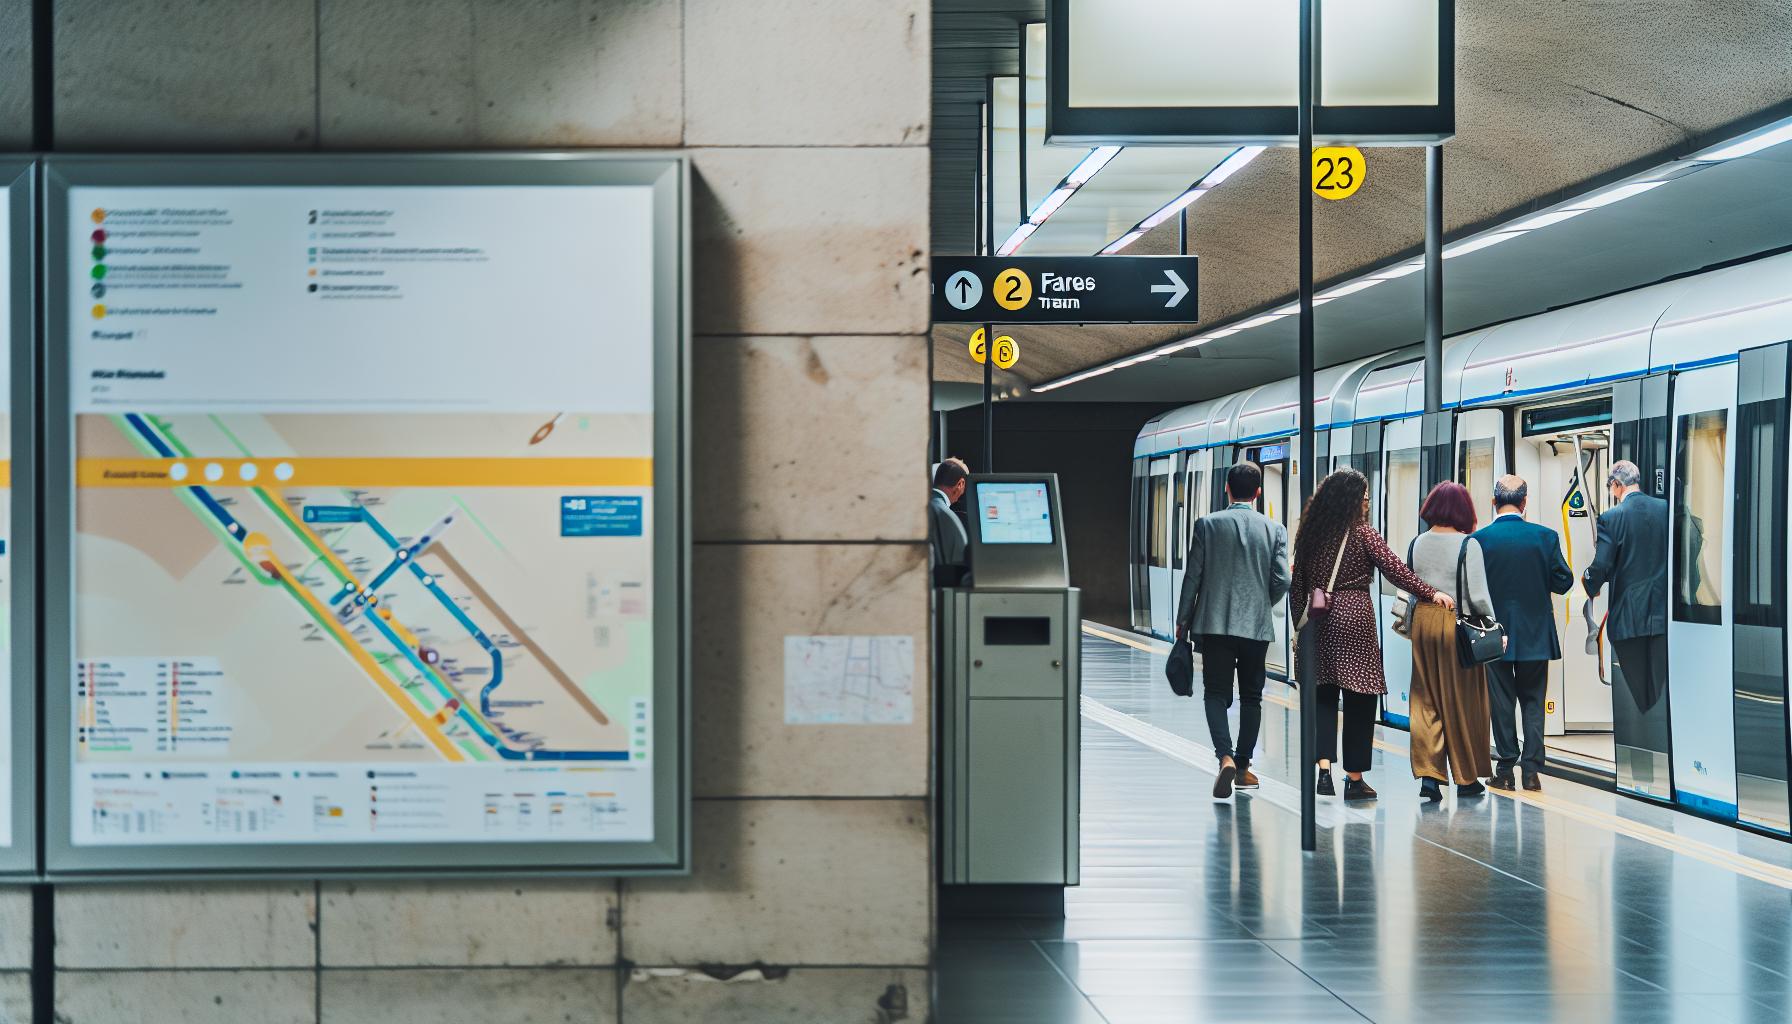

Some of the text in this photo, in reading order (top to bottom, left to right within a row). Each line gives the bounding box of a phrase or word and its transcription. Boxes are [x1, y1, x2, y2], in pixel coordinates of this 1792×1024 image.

[1316, 157, 1353, 189] 23
[1005, 272, 1096, 301] 2 Fares
